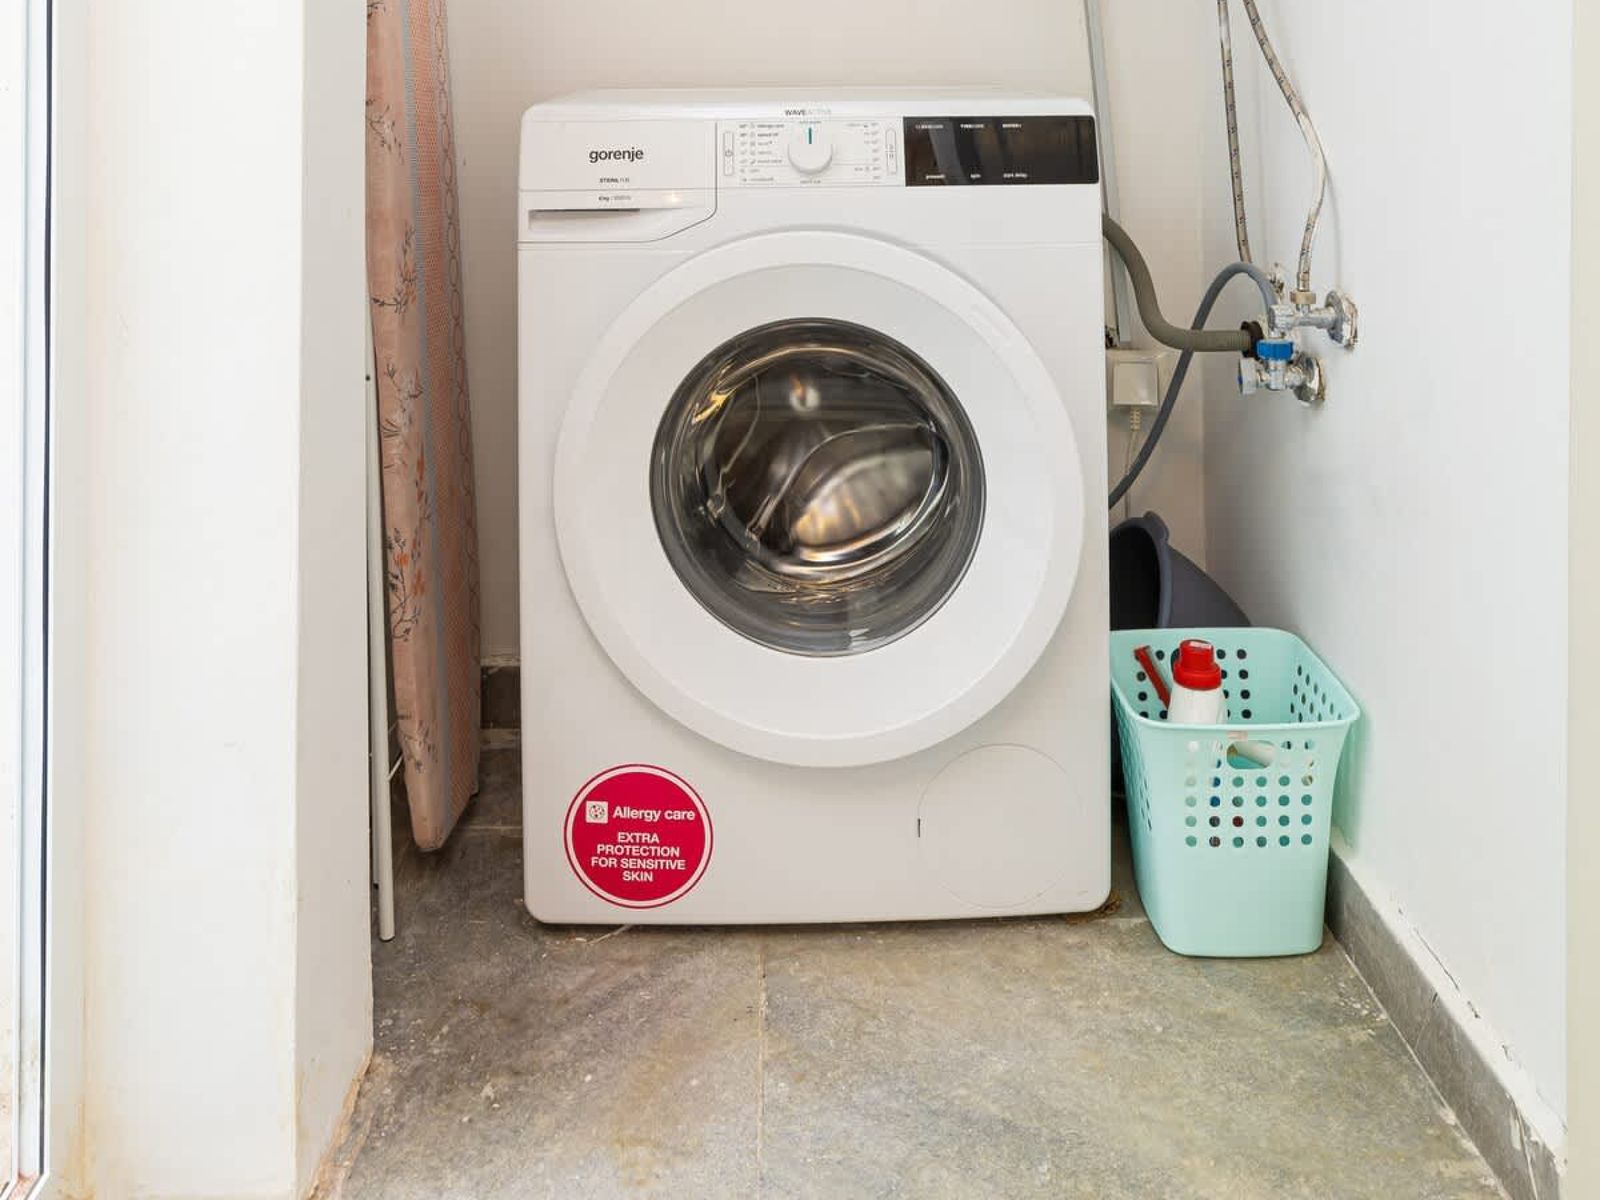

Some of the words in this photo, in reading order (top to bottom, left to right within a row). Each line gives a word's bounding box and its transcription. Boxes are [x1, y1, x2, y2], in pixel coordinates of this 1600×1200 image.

[589, 147, 644, 163] gorenje
[612, 806, 660, 822] Allergy
[664, 809, 696, 821] care
[617, 832, 660, 844] EXTRA
[596, 844, 680, 857] PROTECTION
[591, 857, 617, 868] FOR
[620, 858, 686, 870] SENSITIVE
[622, 871, 653, 882] SKIN
